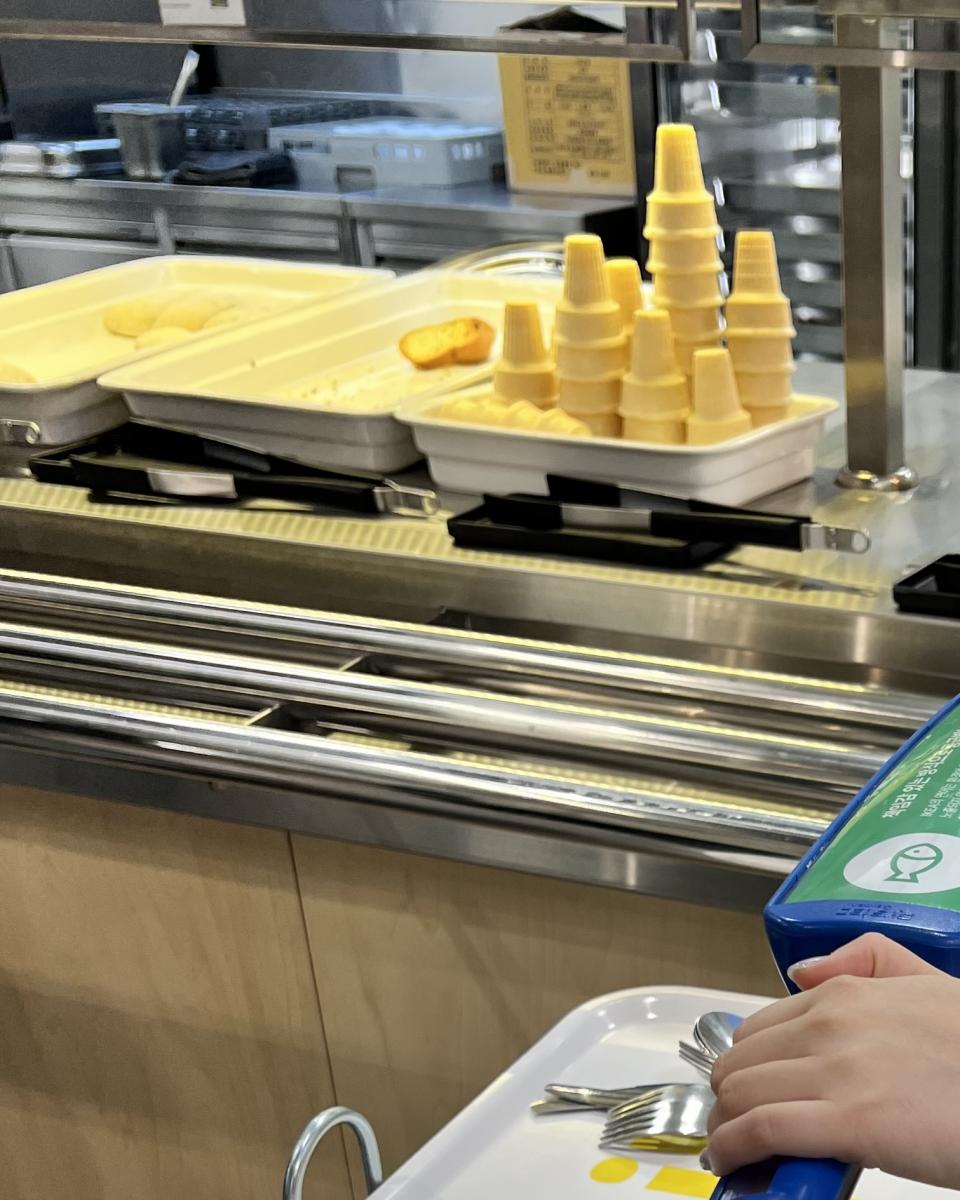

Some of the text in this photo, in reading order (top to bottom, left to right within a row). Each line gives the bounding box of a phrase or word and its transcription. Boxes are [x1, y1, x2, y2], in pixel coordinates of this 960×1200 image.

[916, 748, 954, 778] 방식으로
[902, 776, 931, 792] 있는
[881, 793, 918, 818] 책임감
